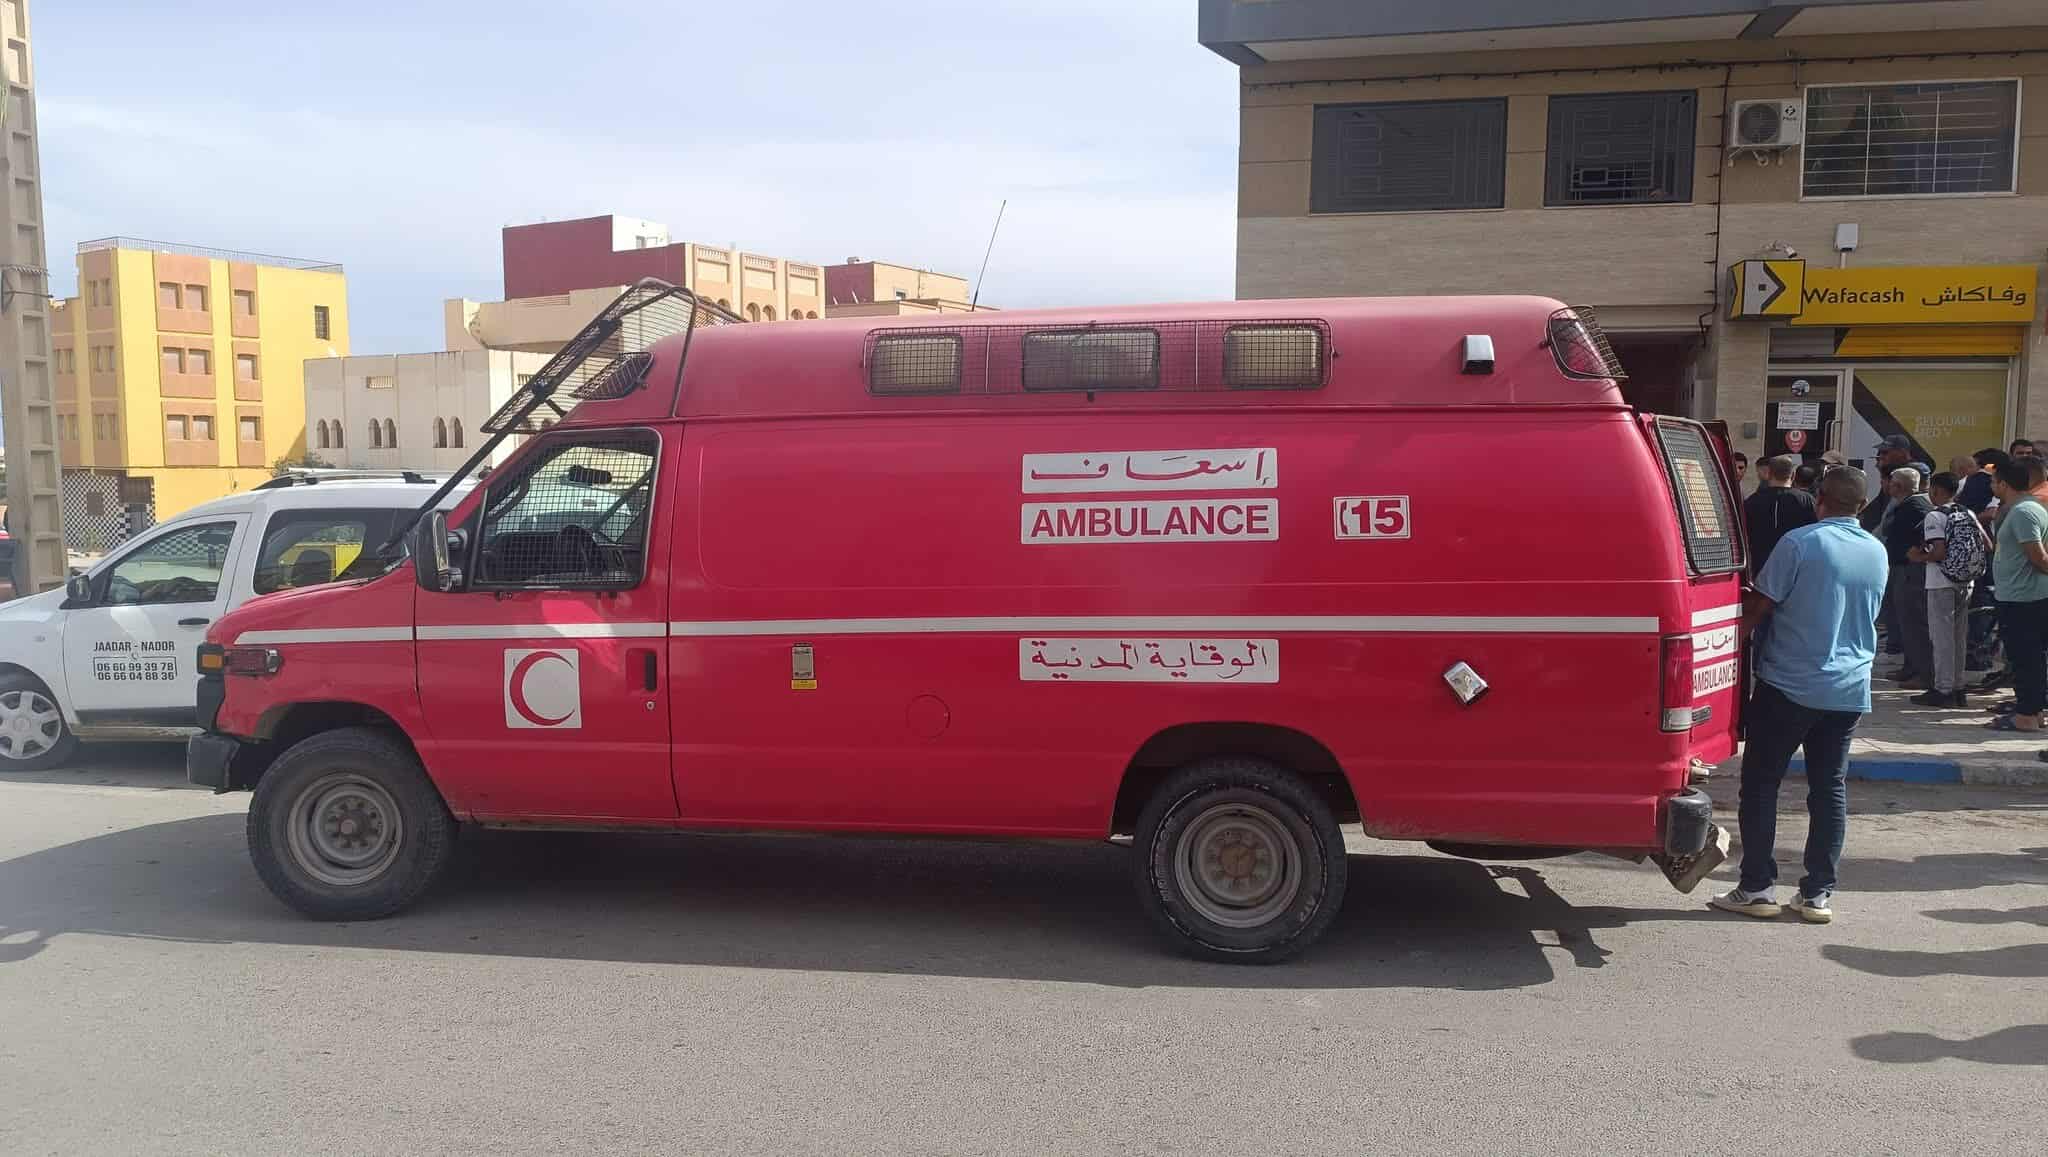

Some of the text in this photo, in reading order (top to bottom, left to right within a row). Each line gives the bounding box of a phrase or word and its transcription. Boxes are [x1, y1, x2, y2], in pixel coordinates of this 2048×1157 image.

[1803, 286, 1904, 303] Wafacash
[1921, 285, 2026, 306] وفاكاش
[1031, 504, 1269, 538] AMBULANCE
[1351, 500, 1405, 534] 15
[94, 641, 132, 652] JAADAR
[141, 641, 175, 651] NADOR
[97, 662, 110, 672] 06
[128, 662, 142, 672] 99
[144, 662, 158, 671] 39
[160, 662, 174, 671] 78
[1031, 640, 1268, 679] الوقاية المدنية
[98, 672, 111, 681] 06
[114, 672, 127, 681] 66
[129, 672, 143, 681] 04
[1693, 662, 1737, 693] AMBULANCE
